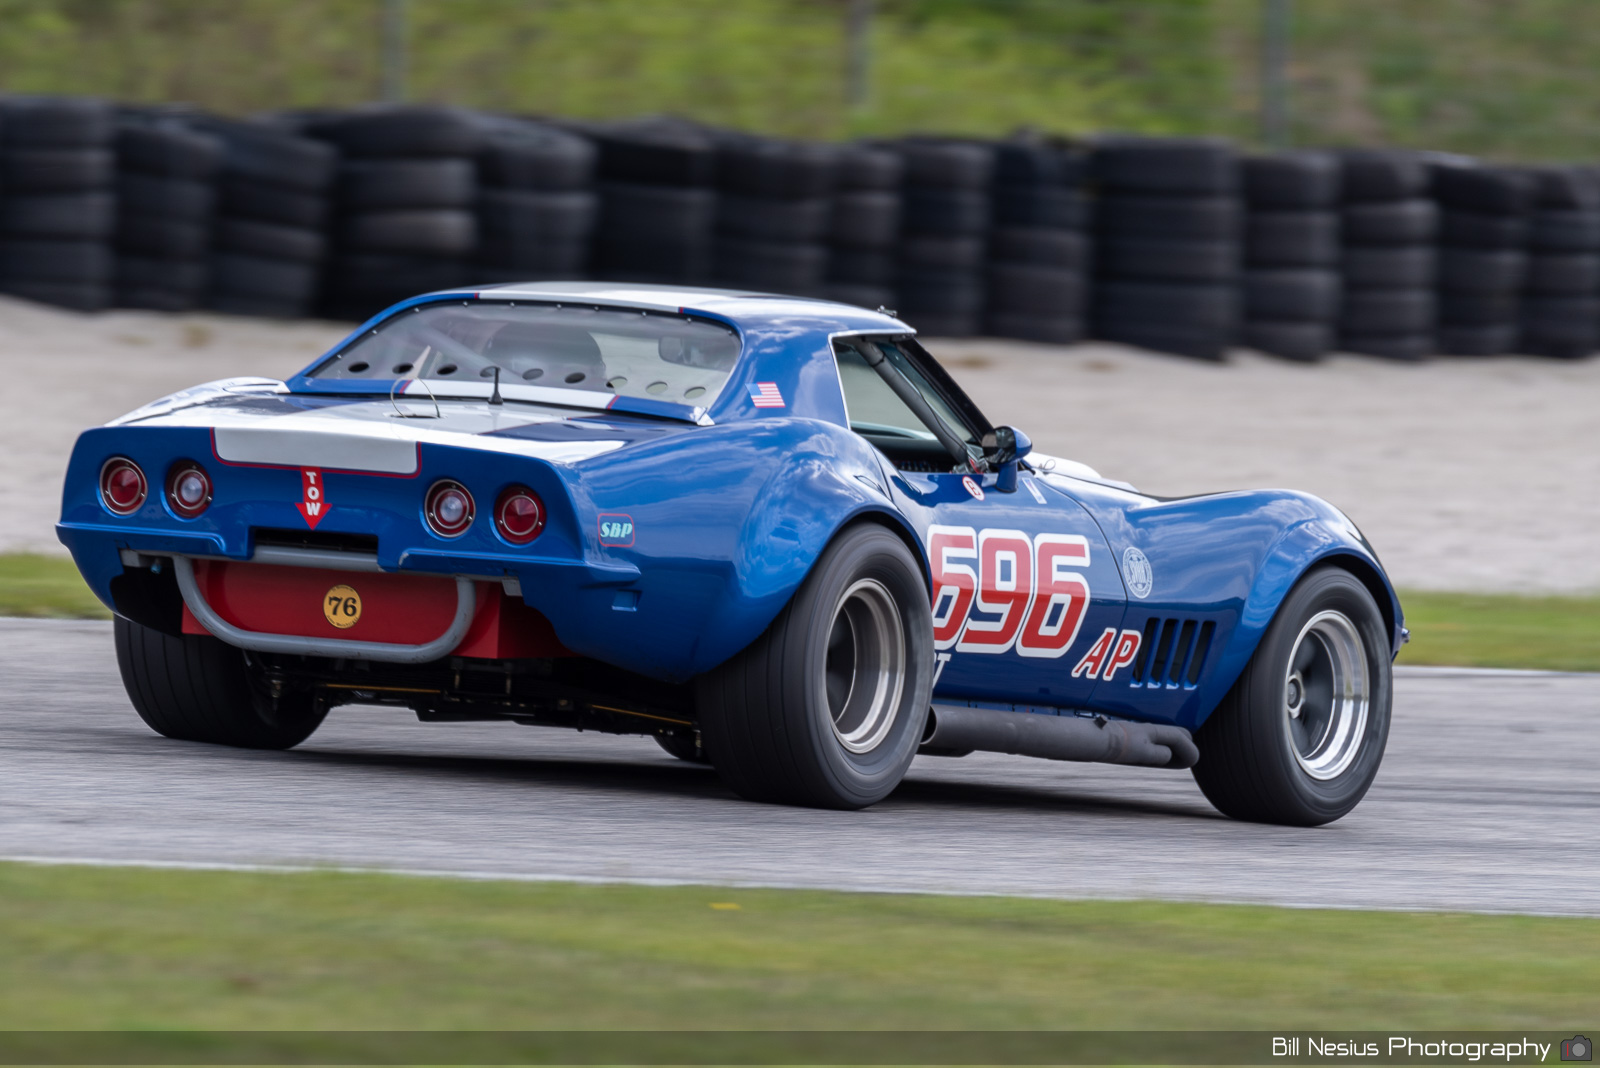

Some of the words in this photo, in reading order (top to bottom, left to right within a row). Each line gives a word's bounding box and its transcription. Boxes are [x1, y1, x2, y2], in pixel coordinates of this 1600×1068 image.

[305, 471, 321, 516] TOW
[600, 522, 633, 538] SBP
[328, 596, 357, 617] 76
[927, 524, 1091, 658] 696
[1071, 627, 1142, 681] AP
